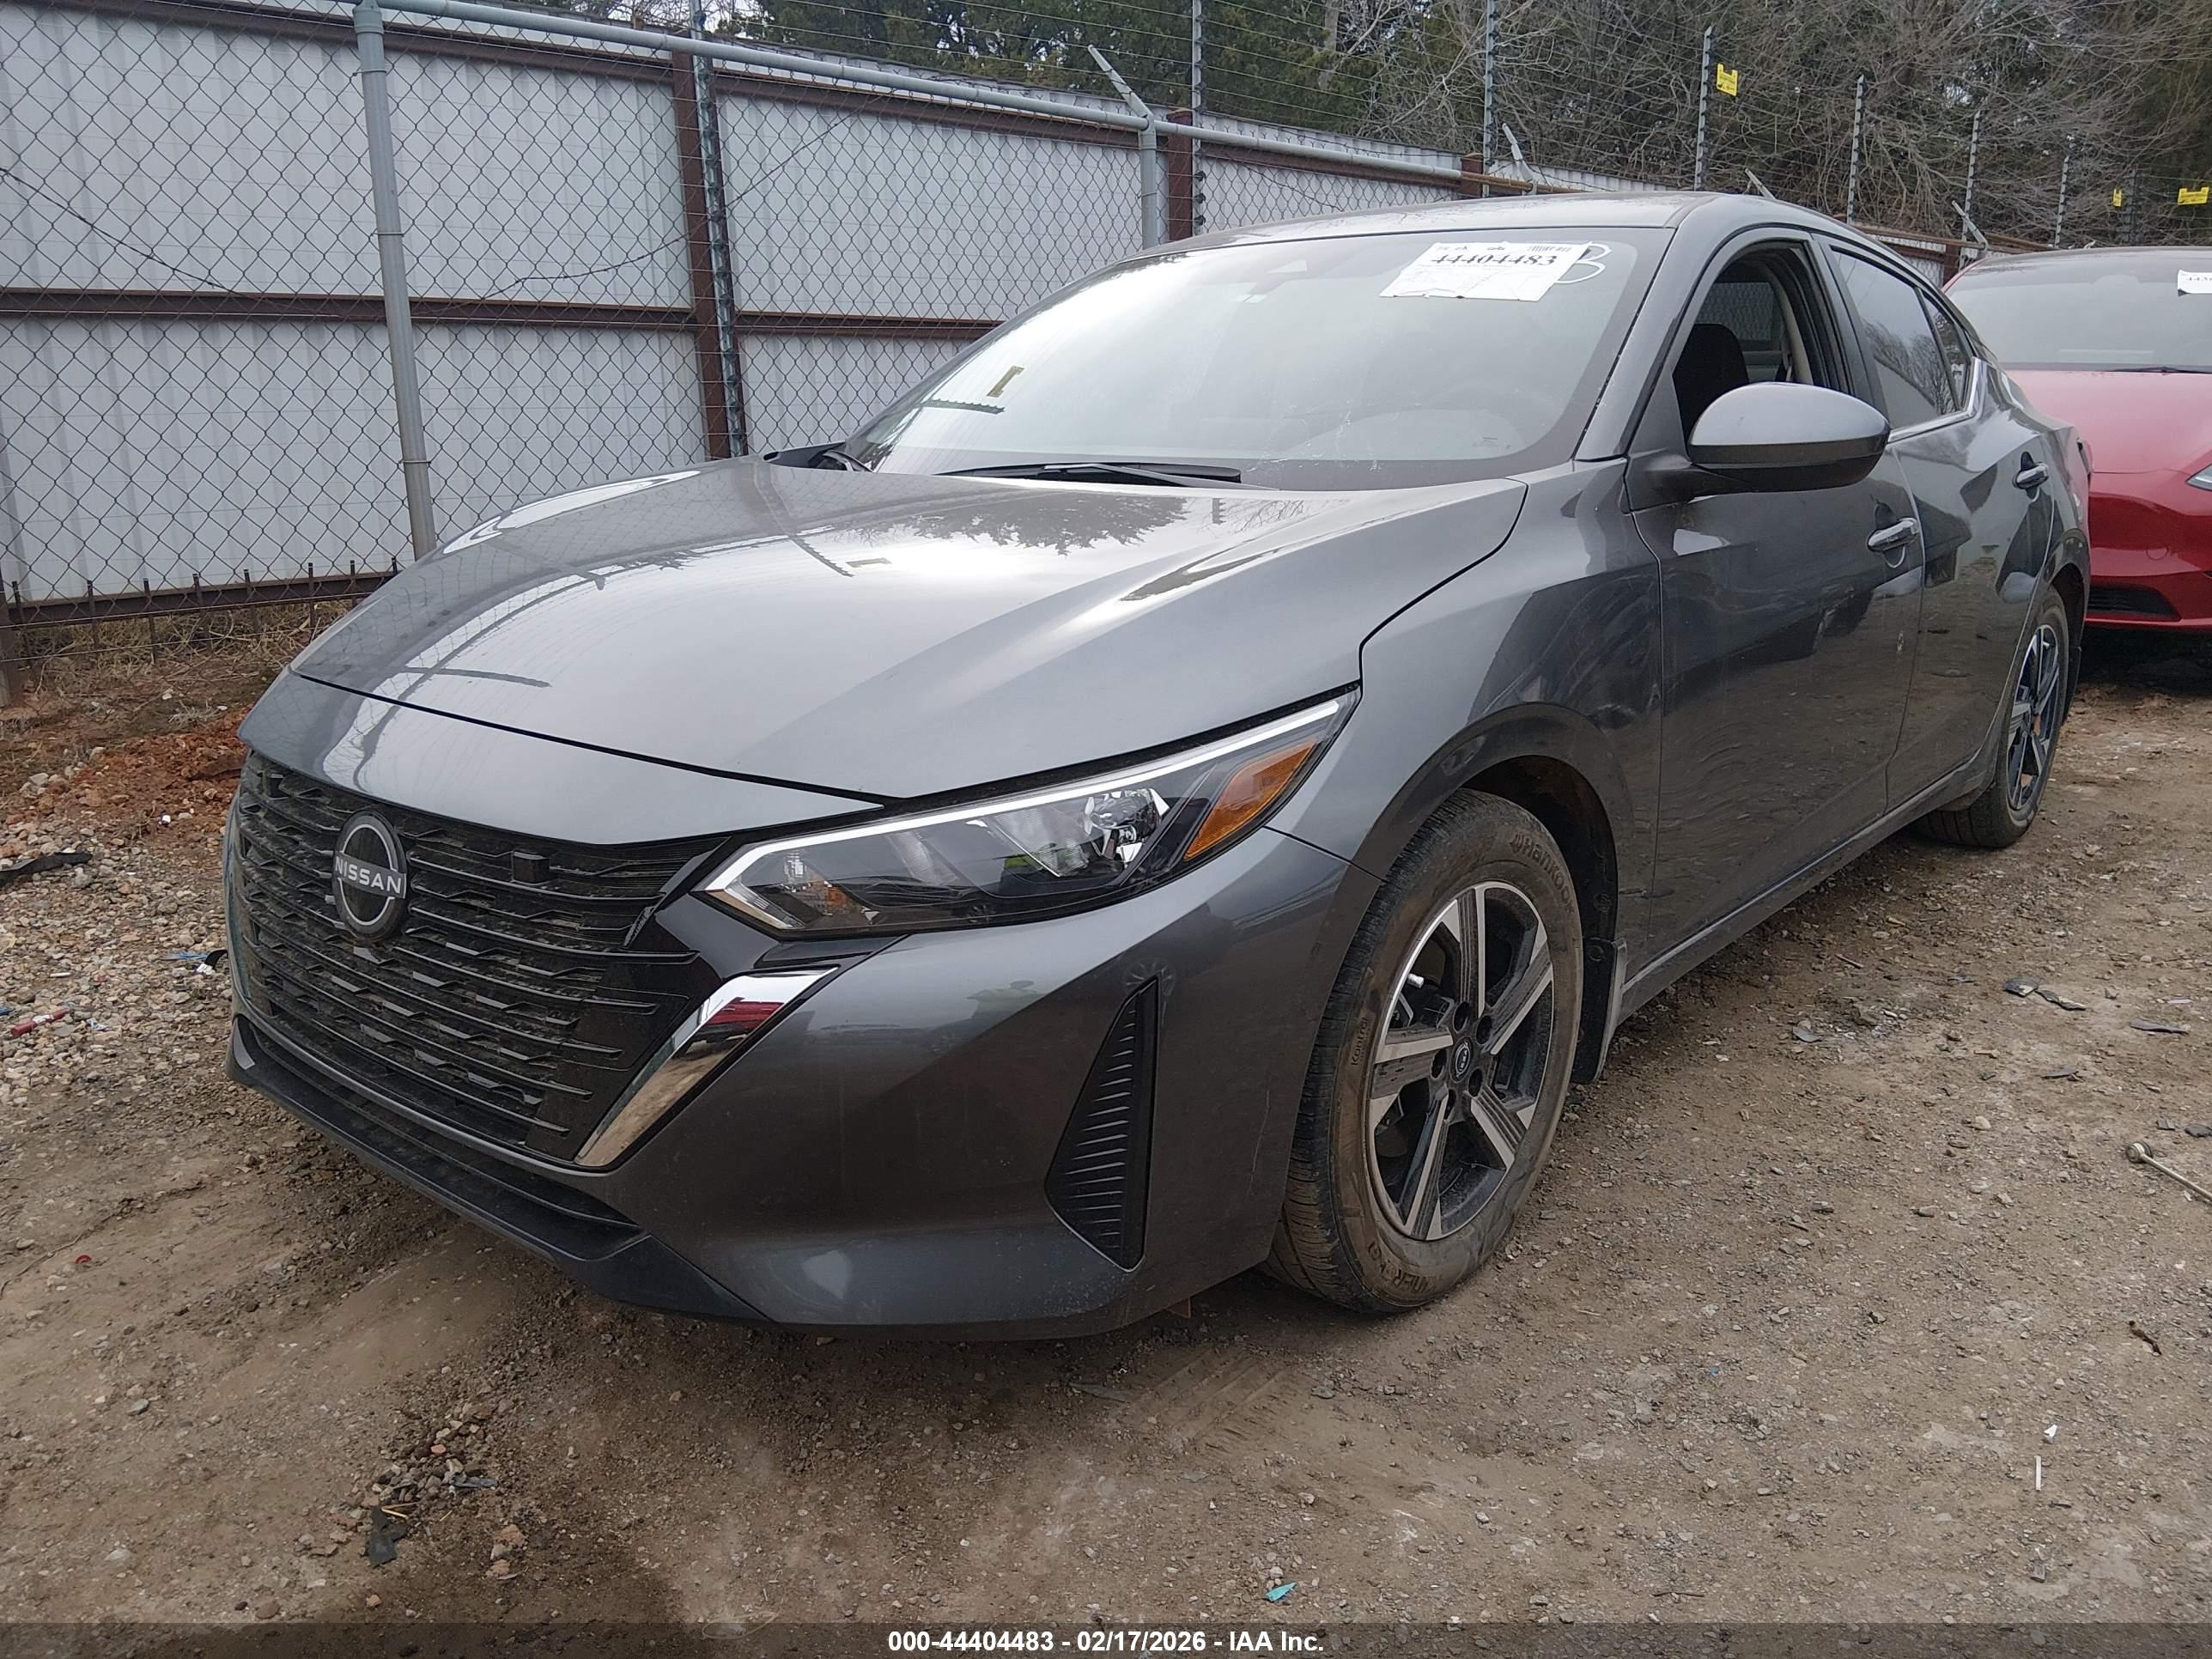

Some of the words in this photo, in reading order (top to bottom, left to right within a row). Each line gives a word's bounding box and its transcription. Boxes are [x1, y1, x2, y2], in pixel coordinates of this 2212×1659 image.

[1431, 253, 1558, 266] 44404483
[335, 855, 402, 895] NISSAN
[1350, 1017, 1369, 1065] Kontrol
